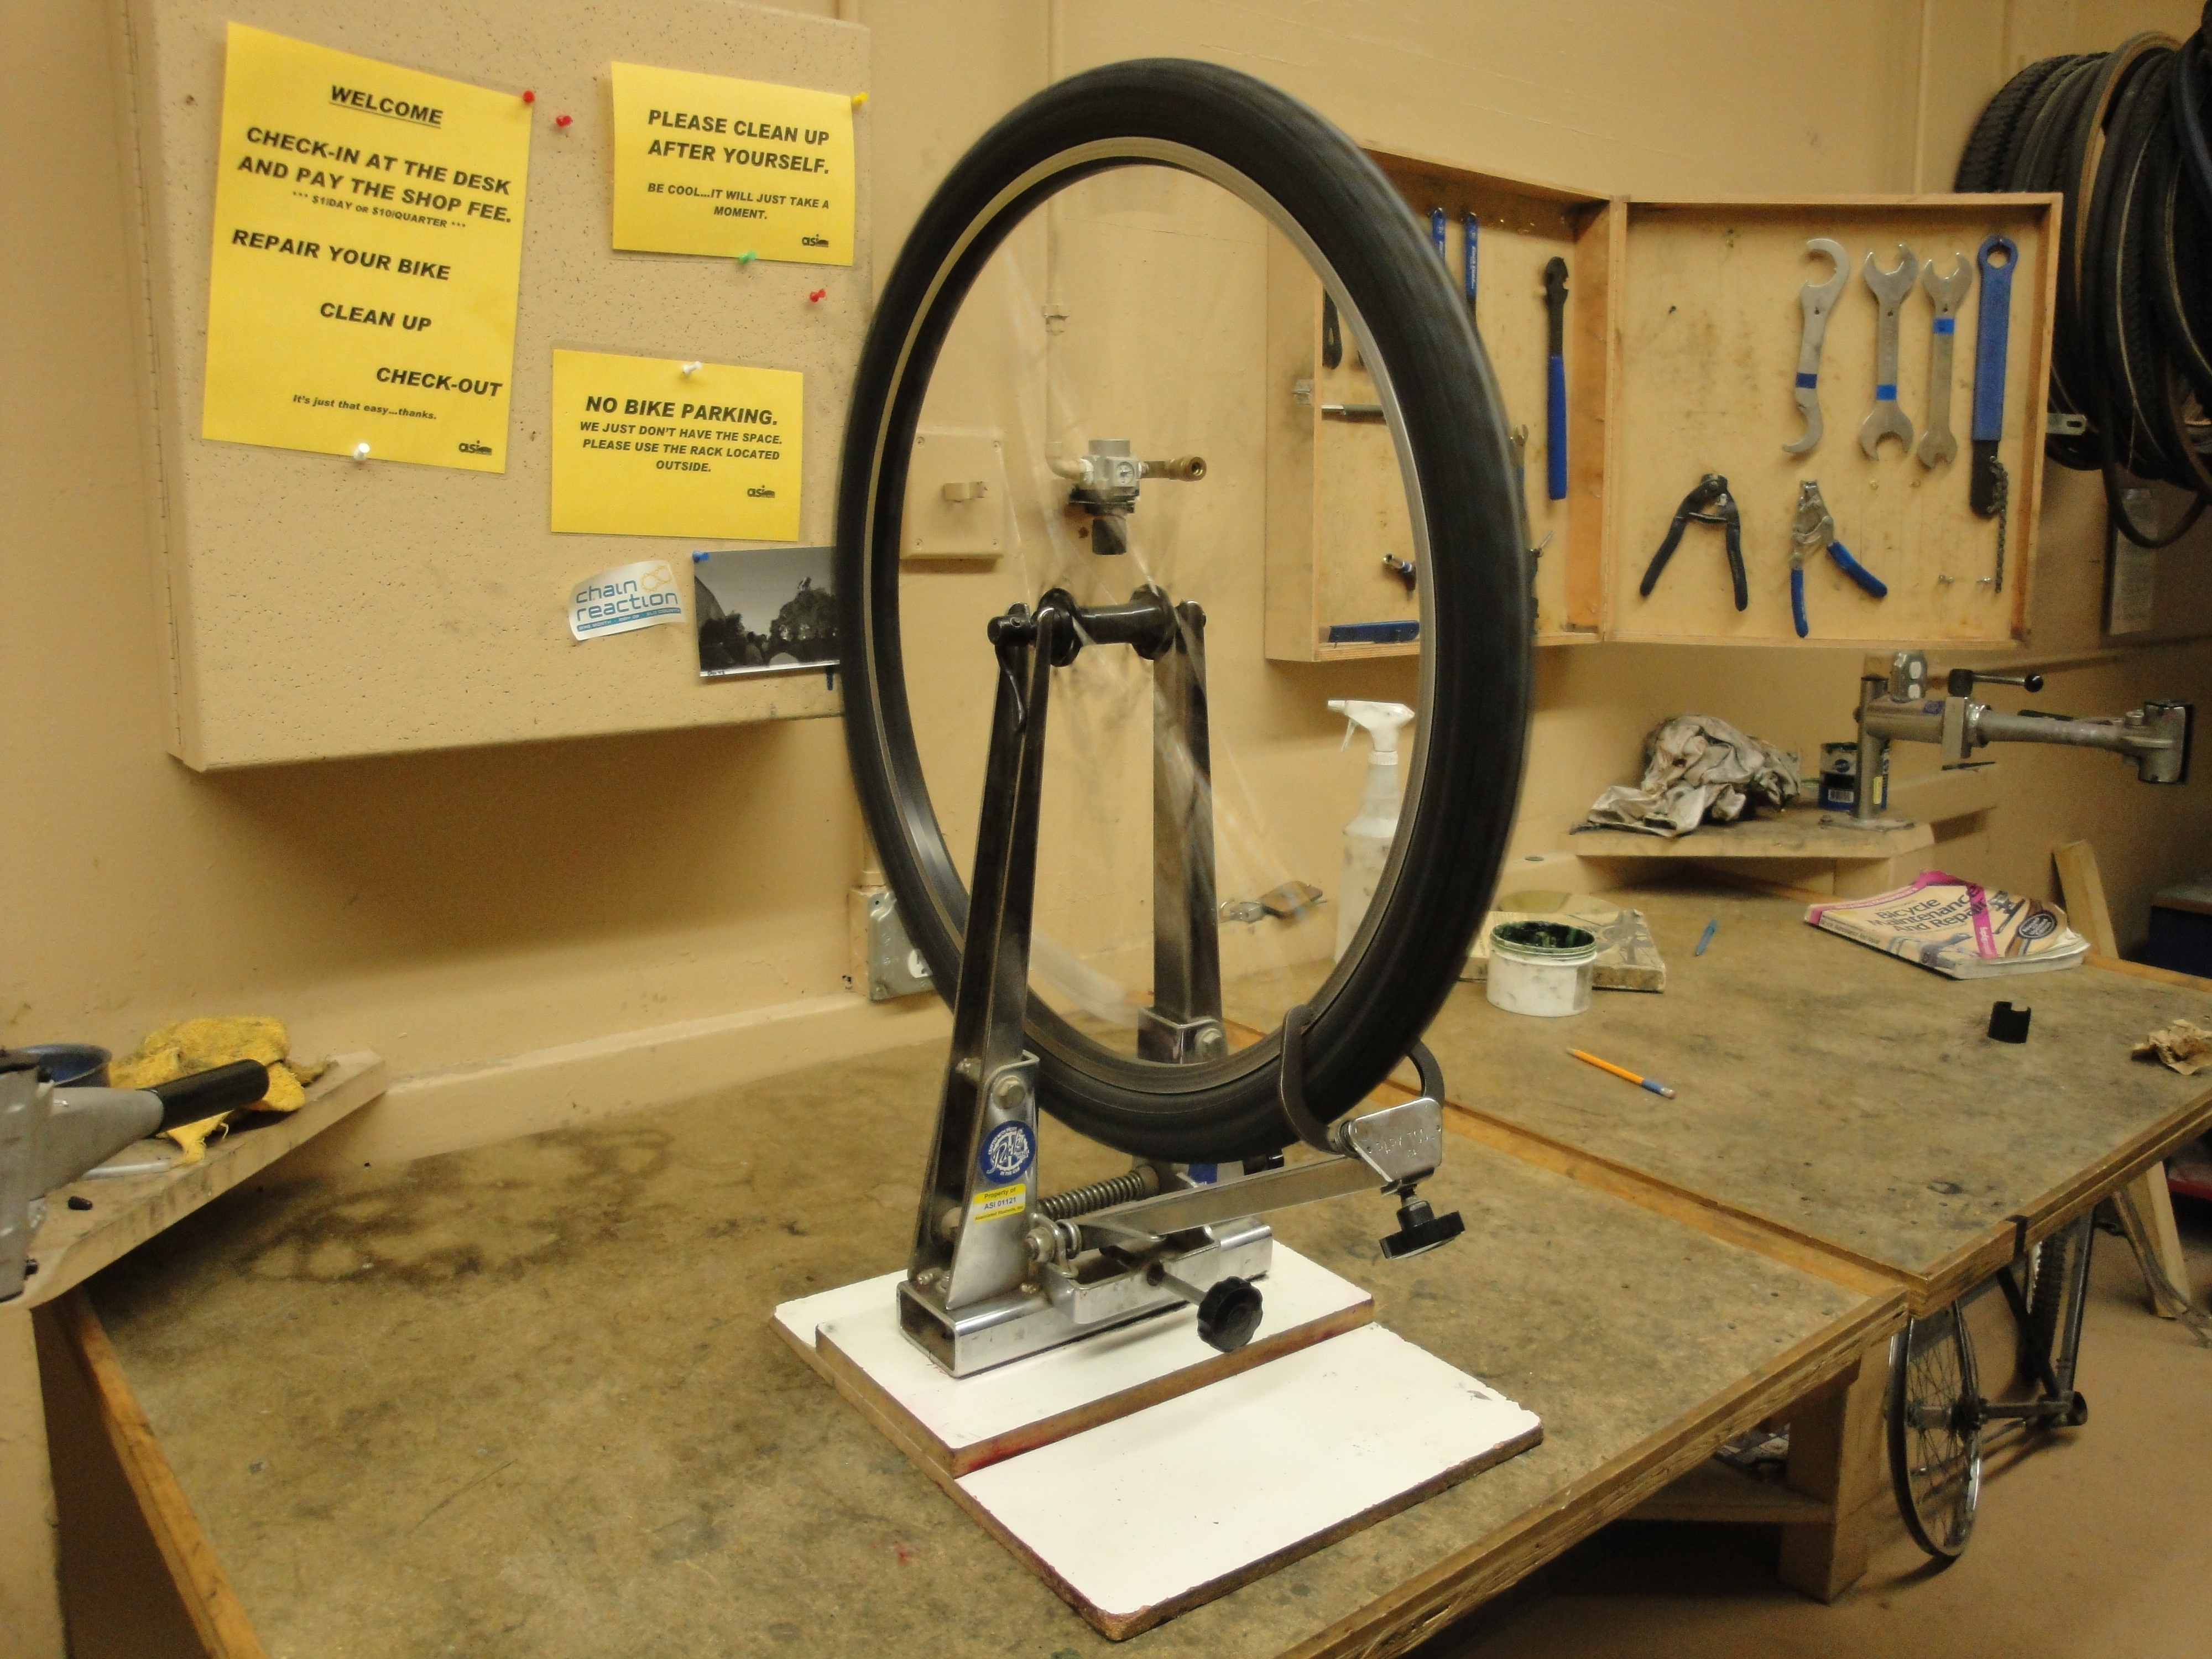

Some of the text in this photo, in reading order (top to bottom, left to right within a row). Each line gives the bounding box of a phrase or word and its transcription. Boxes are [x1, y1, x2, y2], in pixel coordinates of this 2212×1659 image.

[331, 85, 444, 126] WELCOME
[647, 108, 830, 146] PLEASE CLEAN UP
[246, 127, 512, 196] CHECK-IN AT THE DESK
[647, 139, 830, 175] AFTER YOURSELF.
[237, 155, 512, 223] AND PAY THE SHOP FEE.
[647, 182, 830, 210] BE COOL...IT WILL JUST TAKE A
[713, 206, 768, 220] MOMENT.
[231, 228, 451, 281] REPAIR YOUR BIKE
[320, 302, 432, 332] CLEAN UP
[376, 367, 504, 397] CHECK-OUT
[293, 394, 437, 420] It's just that easy...thanks.
[585, 395, 779, 426] NO BIKE PARKING.
[580, 421, 783, 445] WE JUST DON'T HAVE THE SPACE.
[582, 438, 780, 461] PLEASE USE THE RACK LOCATED
[655, 460, 712, 473] OUTSIDE.
[576, 579, 638, 604] chain
[576, 592, 678, 622] reaction
[1867, 885, 1980, 927] Maintenance
[1875, 899, 1941, 920] Bicycle
[1892, 921, 1932, 932] And
[1929, 898, 1987, 928] Repair
[984, 1190, 1009, 1199] Property
[984, 1196, 1016, 1211] ASI 01121
